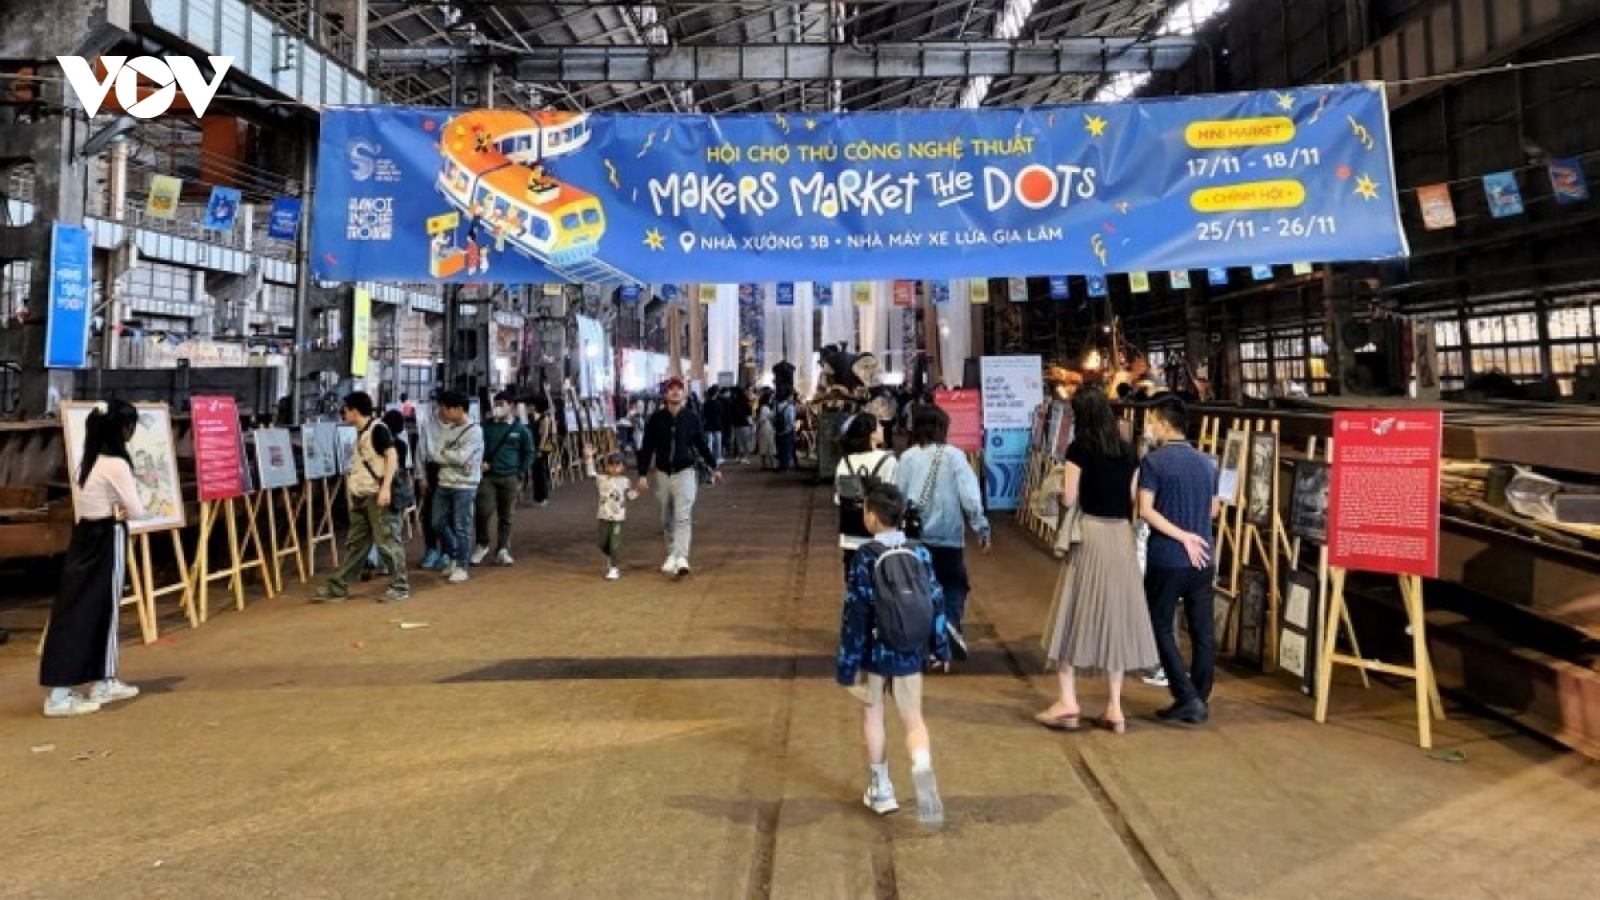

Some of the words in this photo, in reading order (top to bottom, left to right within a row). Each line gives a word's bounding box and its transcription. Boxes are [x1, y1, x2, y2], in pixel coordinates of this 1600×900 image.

[707, 141, 740, 164] HỘI
[747, 143, 791, 165] CHỢ
[844, 139, 901, 161] CÔNG
[1186, 155, 1240, 178] 17/11
[1263, 147, 1320, 169] 18/11
[983, 163, 1096, 212] DOTS
[701, 233, 737, 250] NHÀ
[809, 235, 829, 248] 3B
[847, 230, 883, 248] NHÀ
[928, 231, 948, 246] XE
[992, 228, 1021, 243] GIA
[1196, 218, 1256, 242] 25/11
[1277, 215, 1336, 238] 26/11
